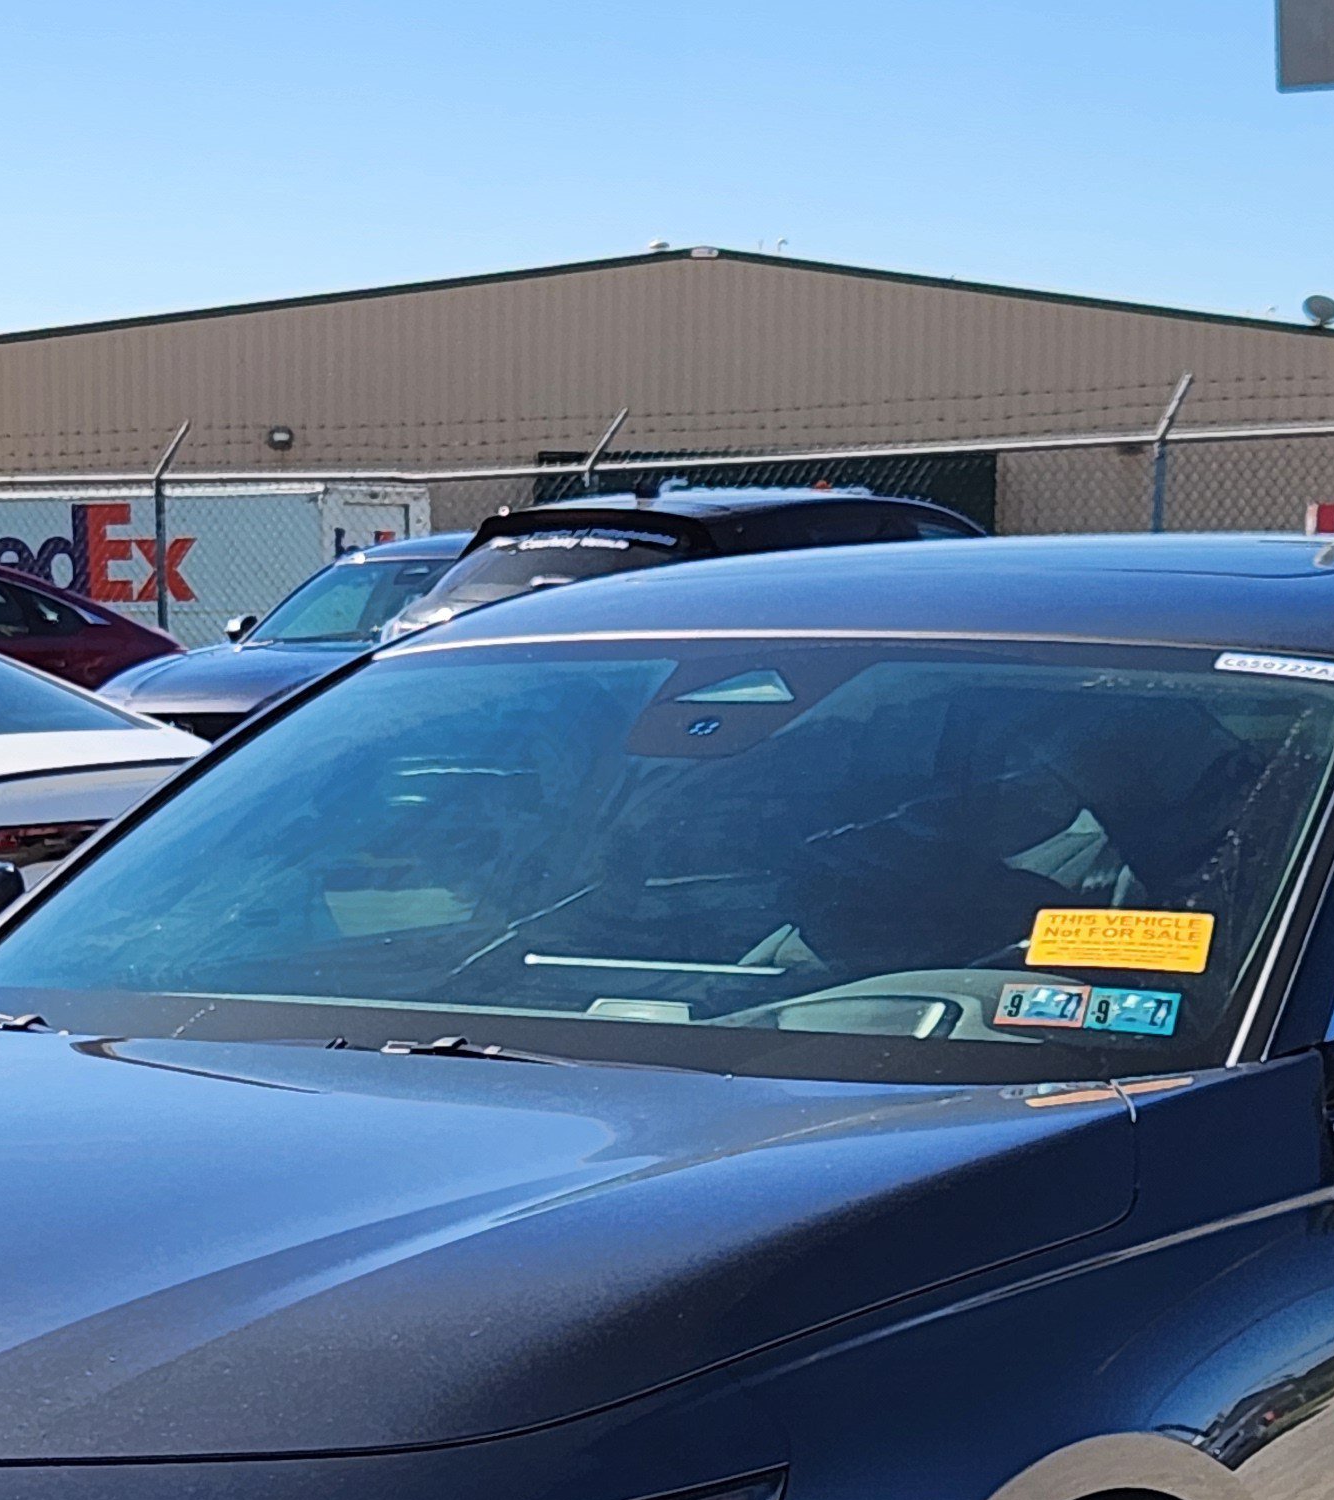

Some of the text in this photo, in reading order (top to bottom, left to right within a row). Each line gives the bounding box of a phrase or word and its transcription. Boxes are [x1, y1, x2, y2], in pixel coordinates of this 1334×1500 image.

[1048, 914, 1202, 929] THIS VEHICLE
[1088, 927, 1135, 939] FOR
[1142, 929, 1201, 941] SALE
